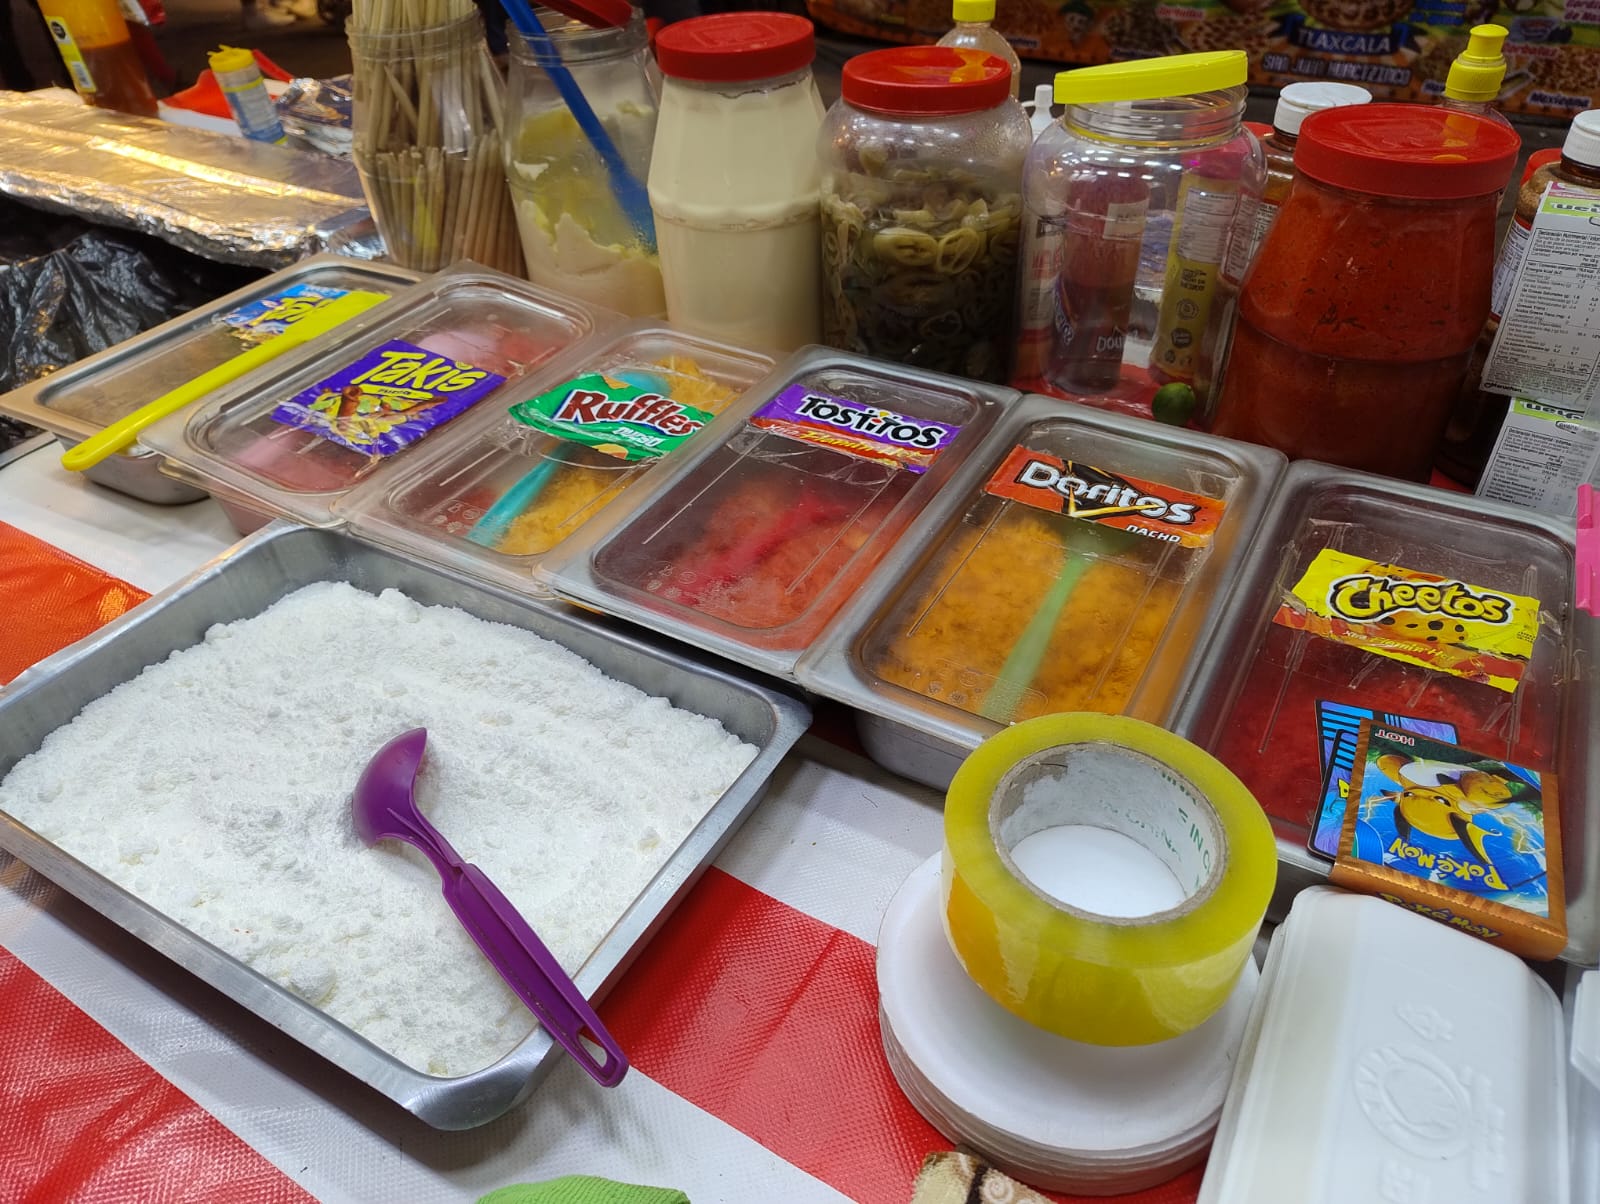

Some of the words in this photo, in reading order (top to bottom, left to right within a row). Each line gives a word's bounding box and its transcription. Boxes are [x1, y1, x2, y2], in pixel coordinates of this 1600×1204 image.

[1296, 27, 1392, 53] TLAXCALA
[350, 351, 488, 393] Takis
[555, 389, 705, 436] Ruffles
[1014, 460, 1202, 525] Doritos
[1126, 524, 1182, 544] NACHO
[1327, 573, 1515, 625] Cheetos
[1374, 729, 1415, 747] HOT
